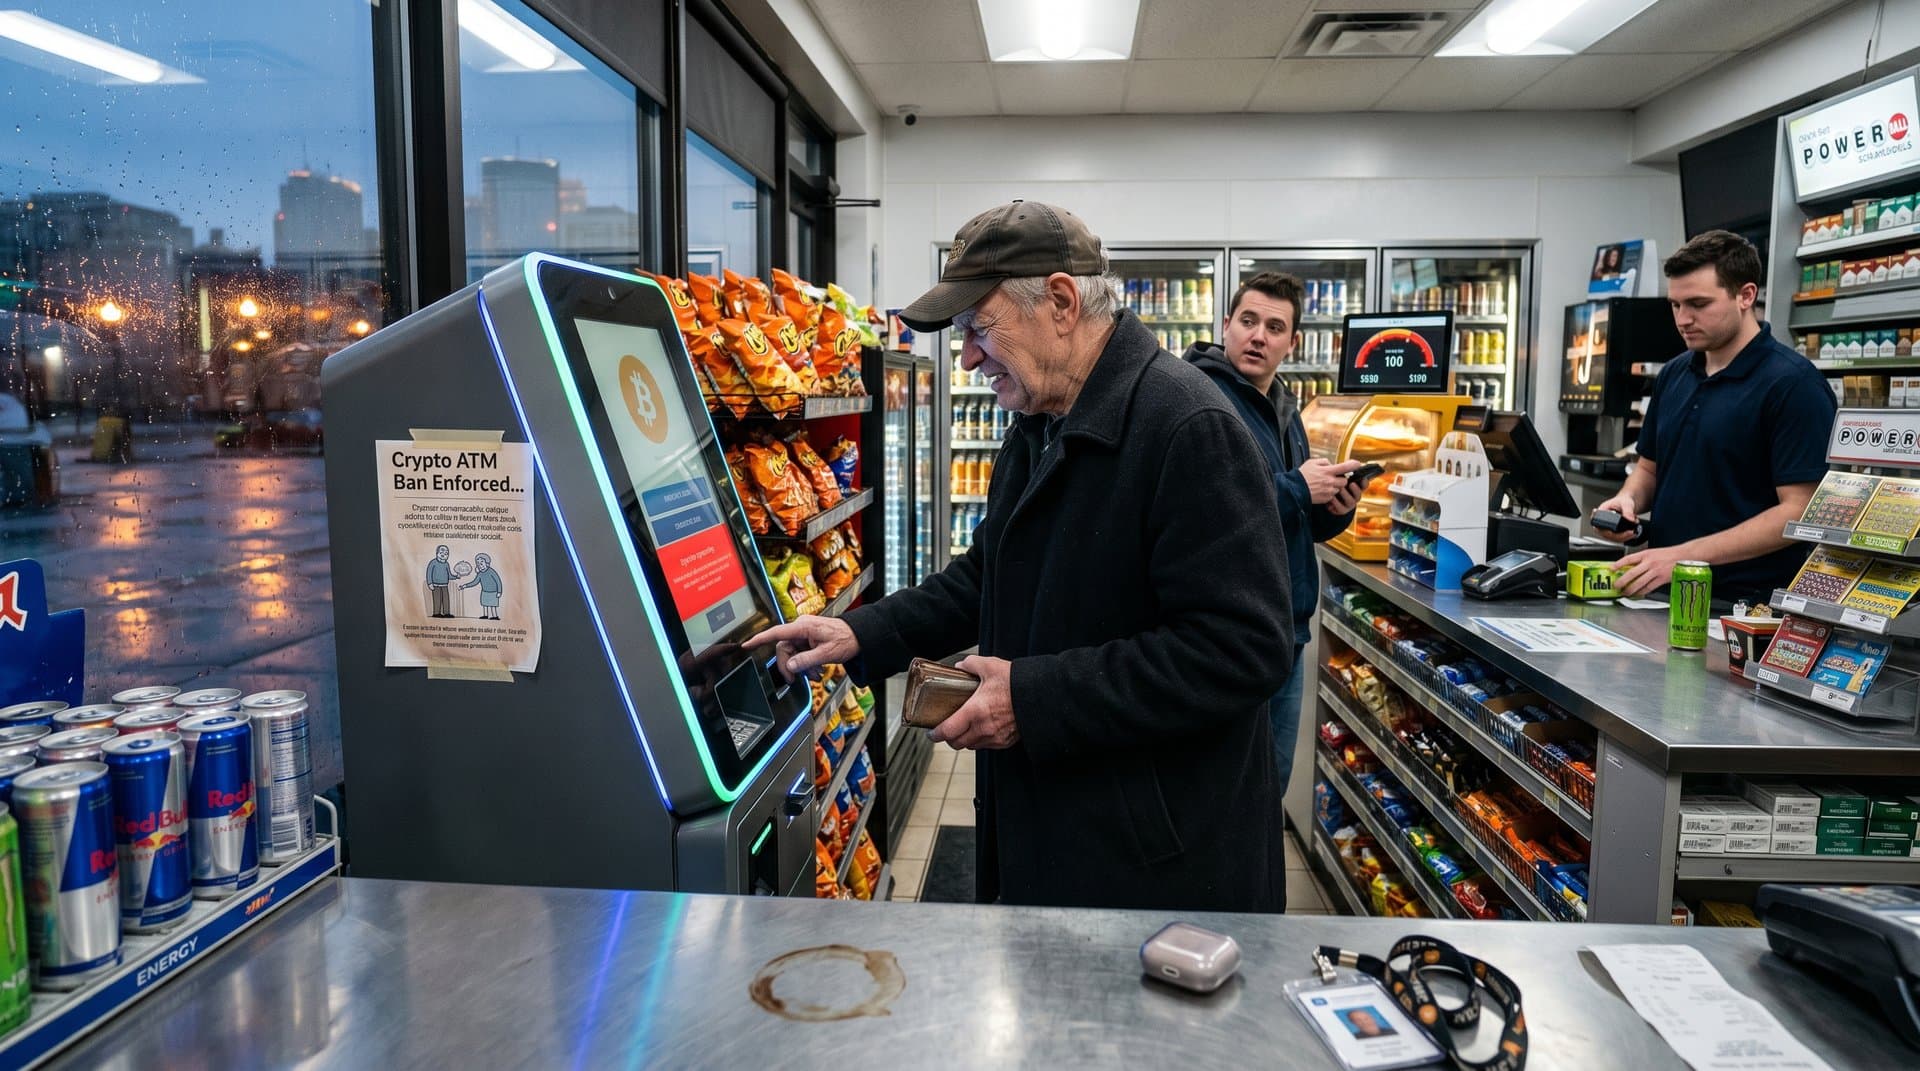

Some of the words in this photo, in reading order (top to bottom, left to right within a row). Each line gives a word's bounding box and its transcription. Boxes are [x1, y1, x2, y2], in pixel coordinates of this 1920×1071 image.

[1803, 124, 1884, 165] POWER
[1385, 355, 1404, 367] 100
[1840, 430, 1915, 446] POWER
[392, 451, 452, 472] Crypto
[456, 452, 497, 469] ATM
[394, 474, 427, 490] Ban
[433, 474, 524, 493] Enforced...
[208, 783, 247, 808] Red
[159, 800, 188, 829] Bul
[136, 936, 198, 987] ENERGY
